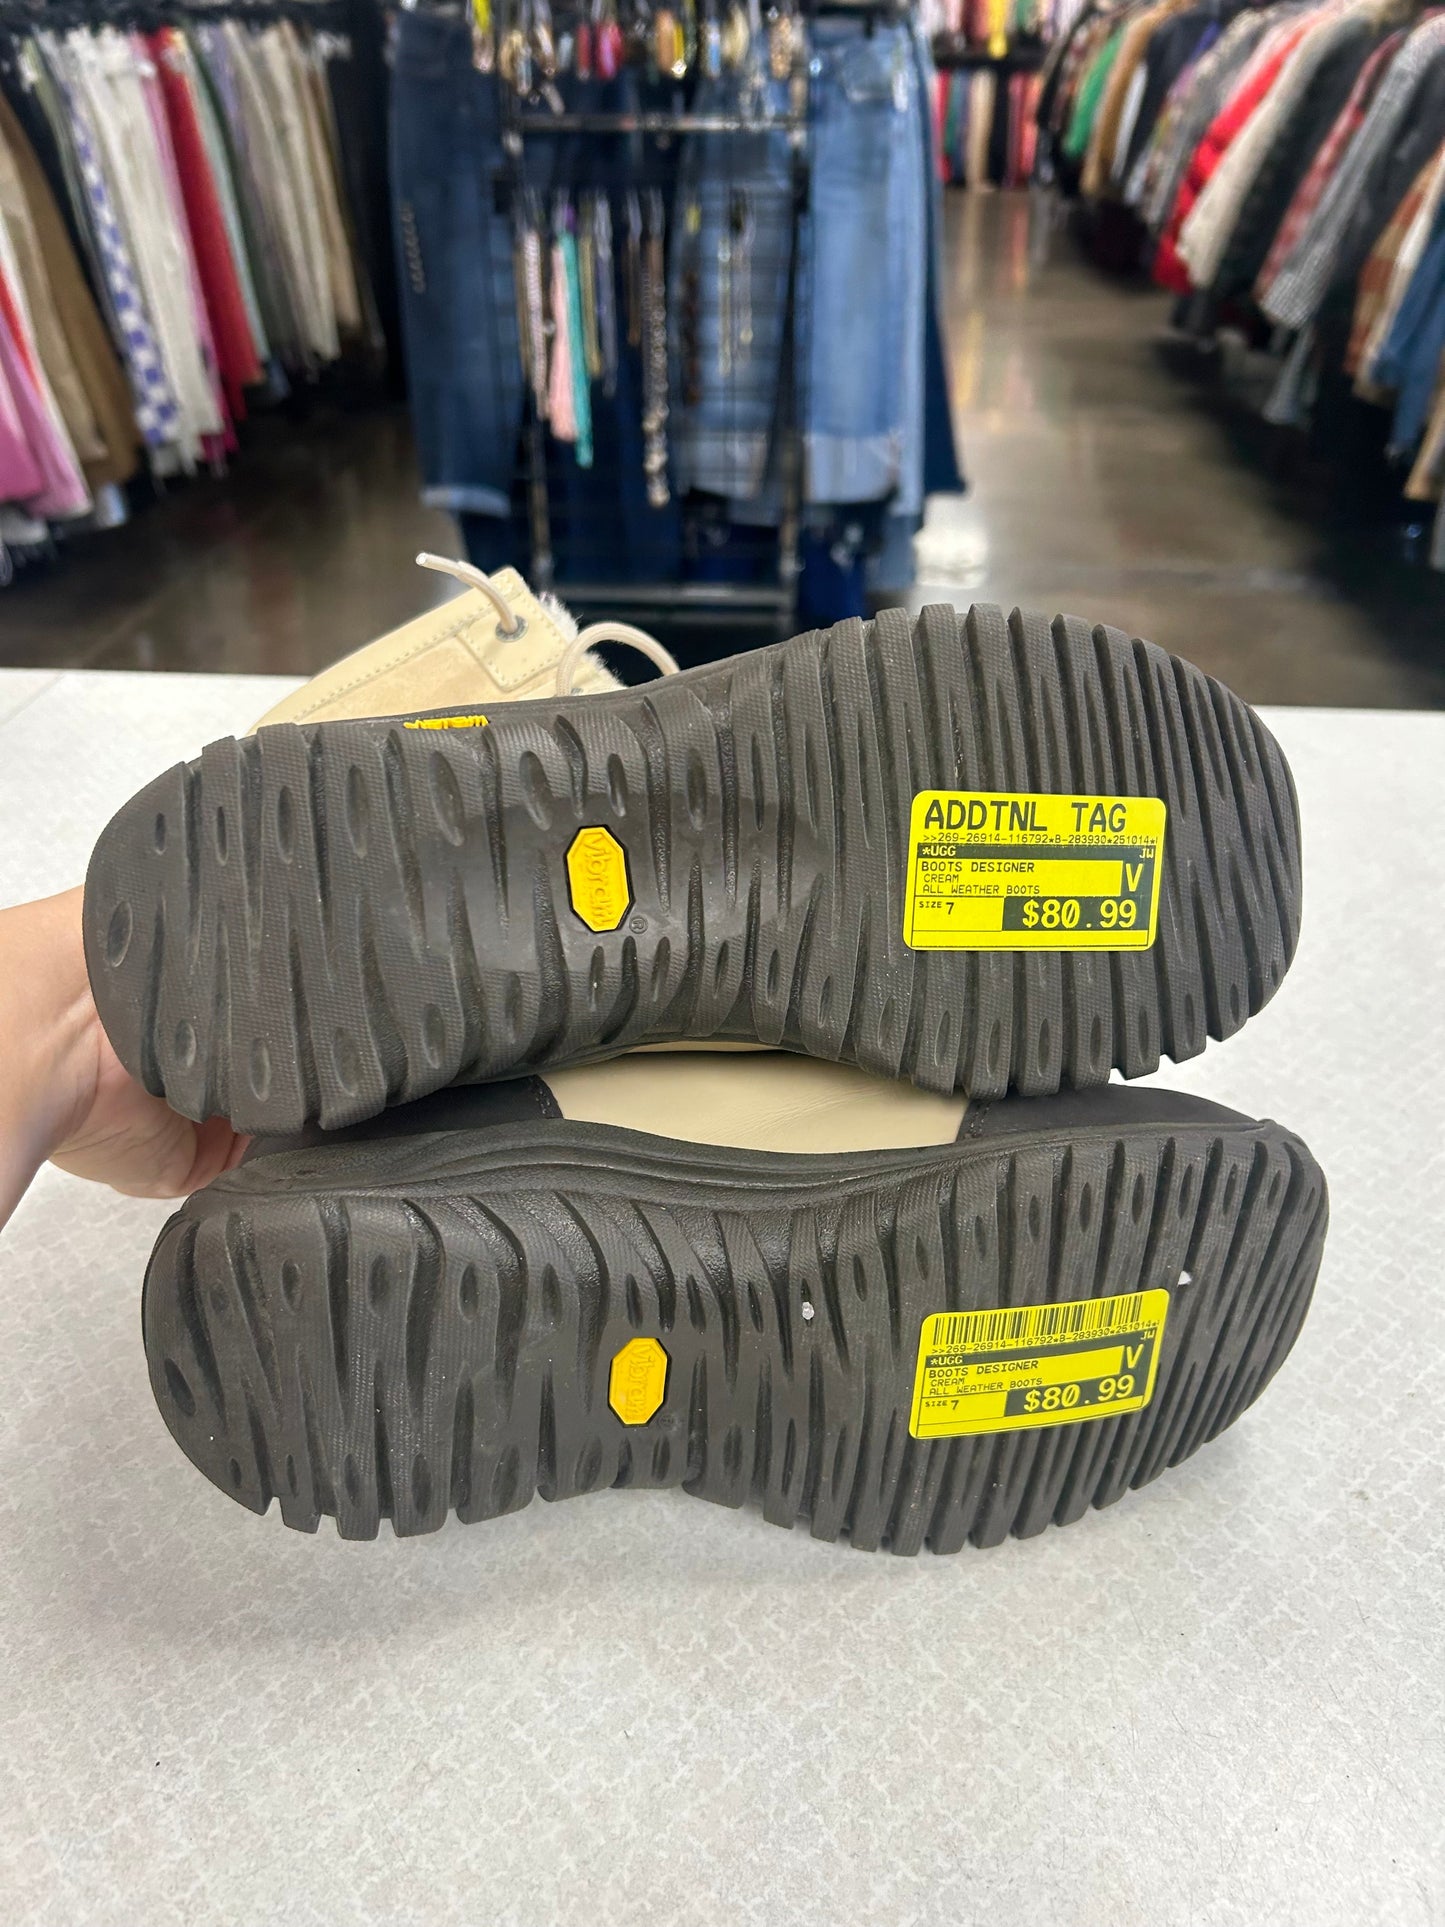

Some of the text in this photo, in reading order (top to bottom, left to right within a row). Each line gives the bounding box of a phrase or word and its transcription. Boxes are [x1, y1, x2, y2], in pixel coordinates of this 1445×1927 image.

[924, 799, 1127, 833] ADDTNL TAG
[1139, 847, 1154, 859] JW
[921, 861, 1035, 873] BOOTS DESIGNER
[924, 873, 959, 883] CREAM
[1126, 863, 1144, 892] V
[923, 884, 1041, 895] ALL WEATHER BOOTS
[919, 901, 955, 915] SIZE 7
[1022, 899, 1137, 928] $80.99
[1126, 1343, 1145, 1369] V
[929, 1360, 1039, 1379] BOOTS DESIGNER
[929, 1377, 1043, 1396] ALL WEATHER BOOTS
[930, 1378, 965, 1387] CREAM
[1023, 1374, 1135, 1412] $80.99
[925, 1400, 959, 1410] SIZE 7
